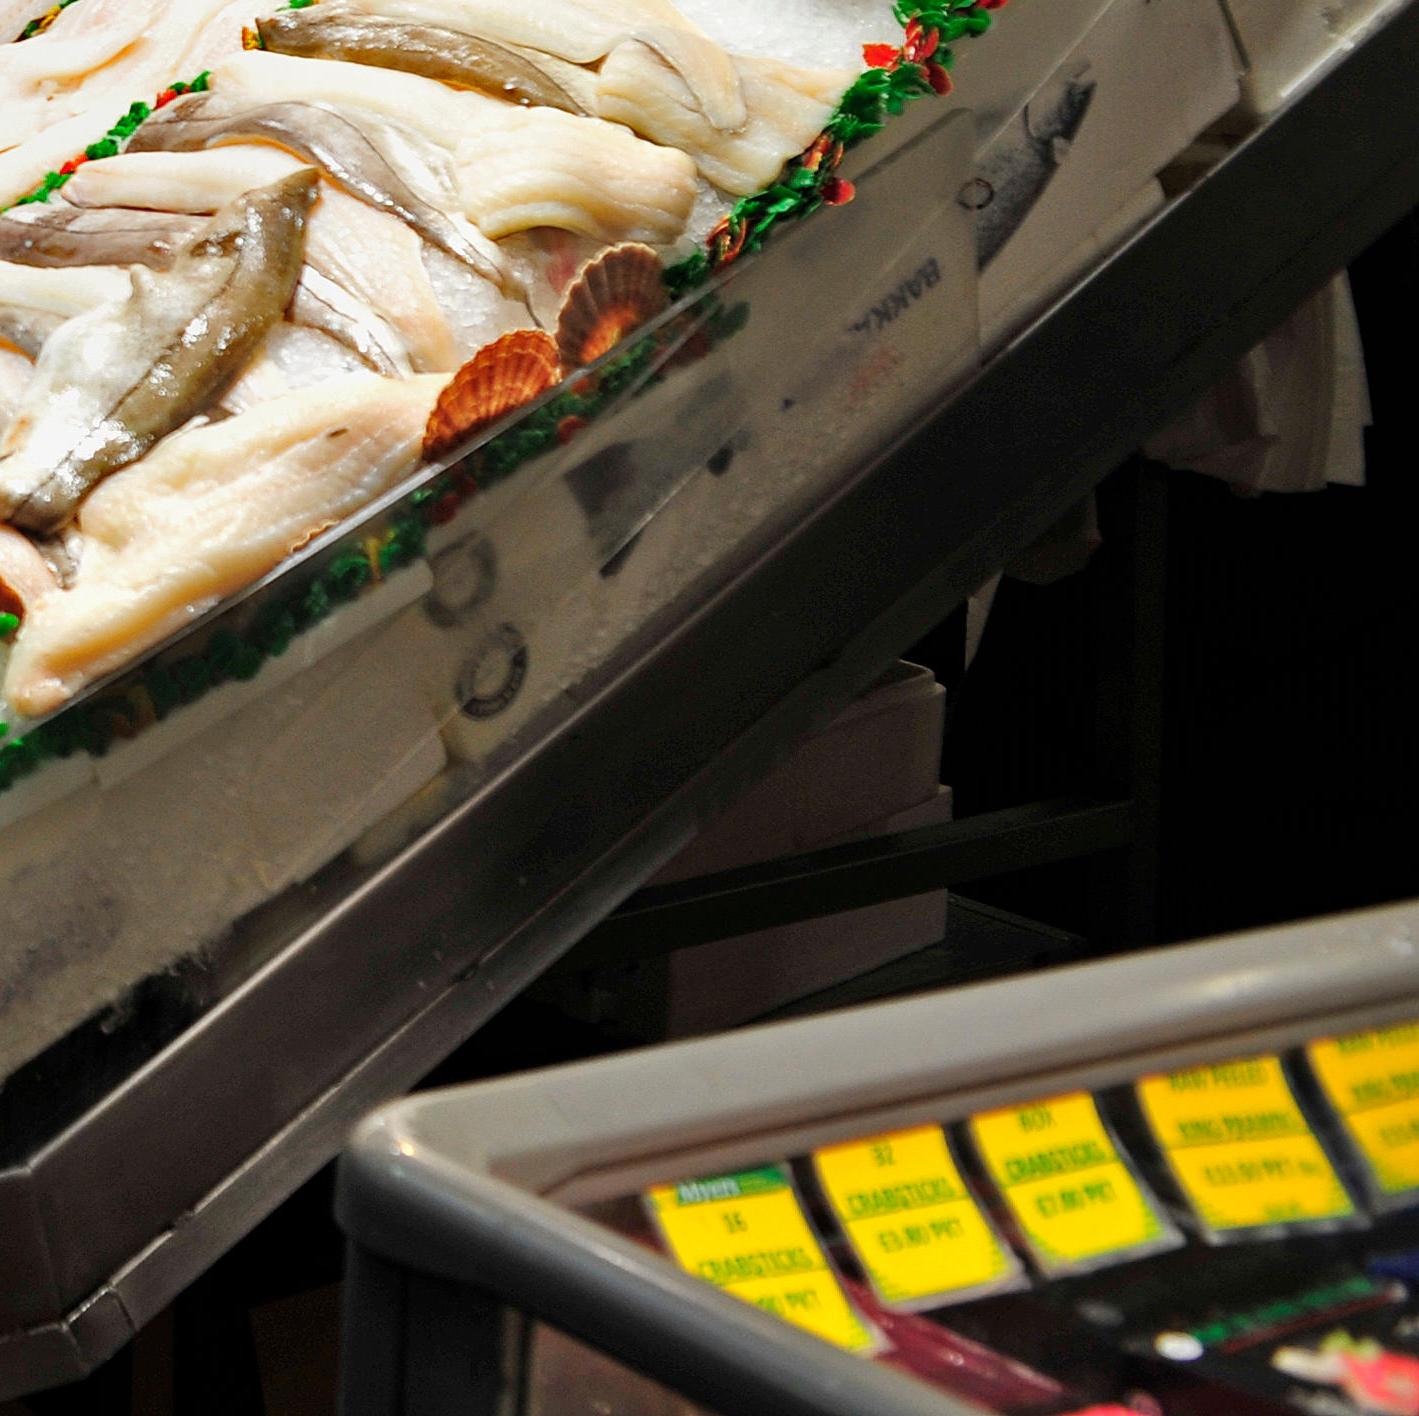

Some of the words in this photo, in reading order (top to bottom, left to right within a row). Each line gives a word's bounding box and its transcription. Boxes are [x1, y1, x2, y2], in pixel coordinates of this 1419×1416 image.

[1019, 1106, 1058, 1133] BOX
[872, 1143, 895, 1168] 32
[1005, 1140, 1107, 1183] CRABSTICKS
[679, 1177, 742, 1203] Myers
[847, 1176, 956, 1216] CRABSTICKS
[697, 1246, 813, 1278] CRABSTICKS
